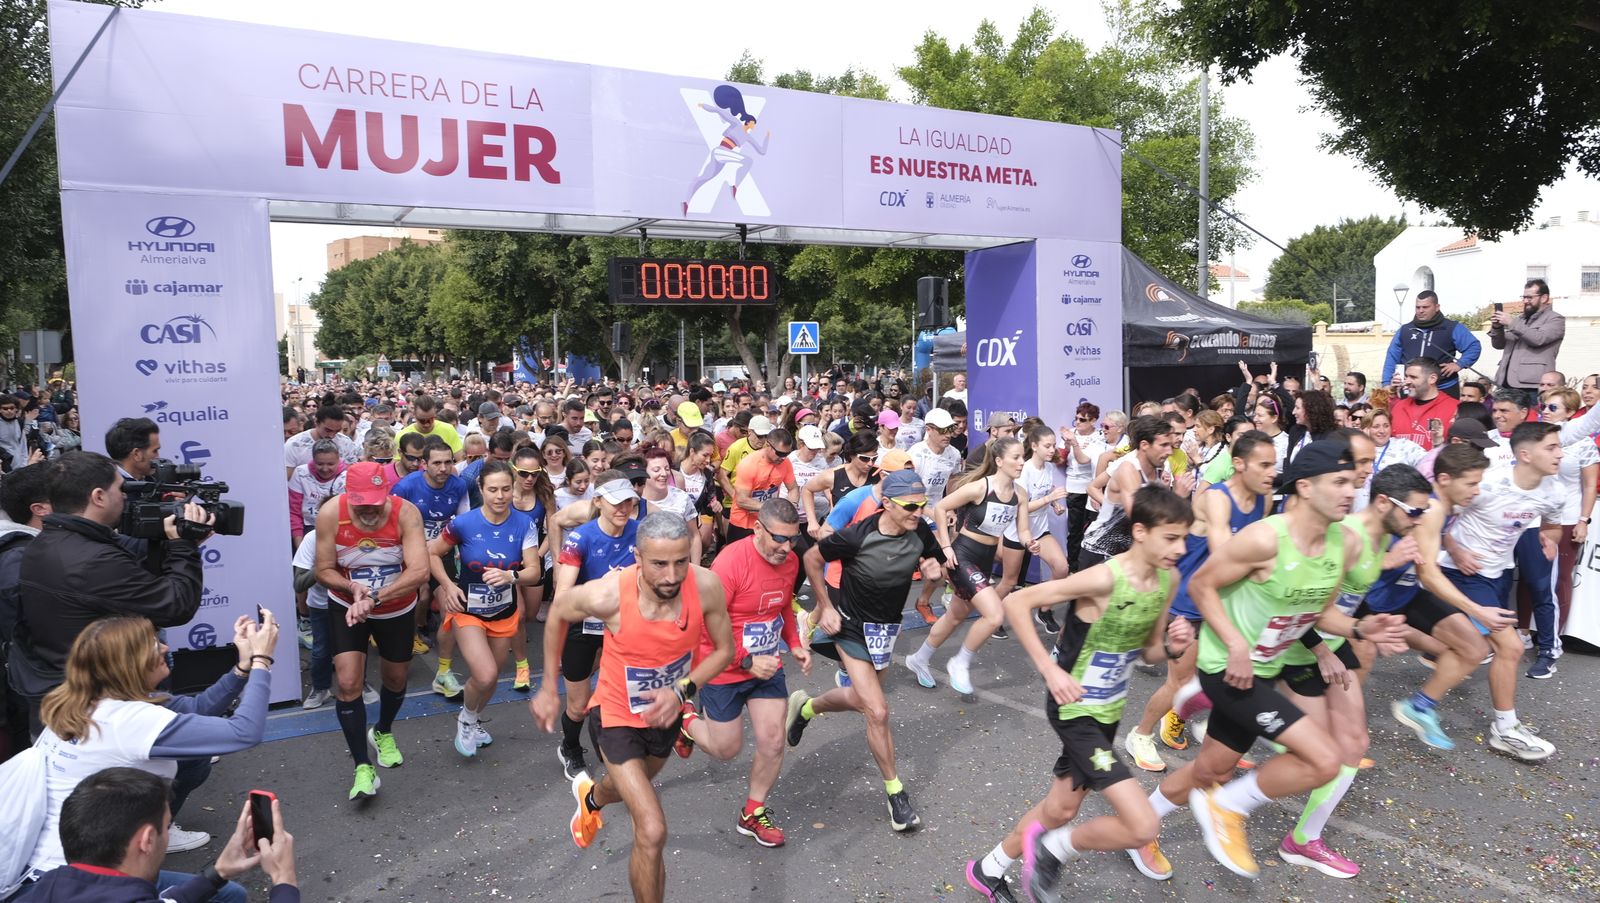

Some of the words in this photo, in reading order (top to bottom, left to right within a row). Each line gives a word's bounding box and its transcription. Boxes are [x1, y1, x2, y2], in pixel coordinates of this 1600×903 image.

[298, 63, 451, 103] CARRERA
[461, 80, 499, 108] DE
[509, 85, 544, 112] LA
[282, 102, 561, 185] MUJER
[899, 126, 922, 146] LA
[926, 129, 1012, 155] IGUALDAD
[870, 155, 894, 175] ES
[899, 157, 982, 183] NUESTRA
[986, 166, 1038, 187] META.
[128, 240, 216, 253] HYUNDAI
[140, 254, 207, 265] Almerialva
[641, 262, 769, 300] 00:00:00
[1063, 269, 1100, 278] HYUNDAI
[153, 280, 224, 296] cajamar
[1073, 295, 1102, 305] cajamar
[140, 323, 202, 344] CASI
[1066, 322, 1092, 336] CASI
[976, 329, 1023, 367] CDX
[1074, 345, 1102, 355] vithas
[164, 360, 227, 375] vithas
[1070, 376, 1101, 388] aqualia
[156, 406, 229, 426] aqualia
[480, 592, 503, 604] 190
